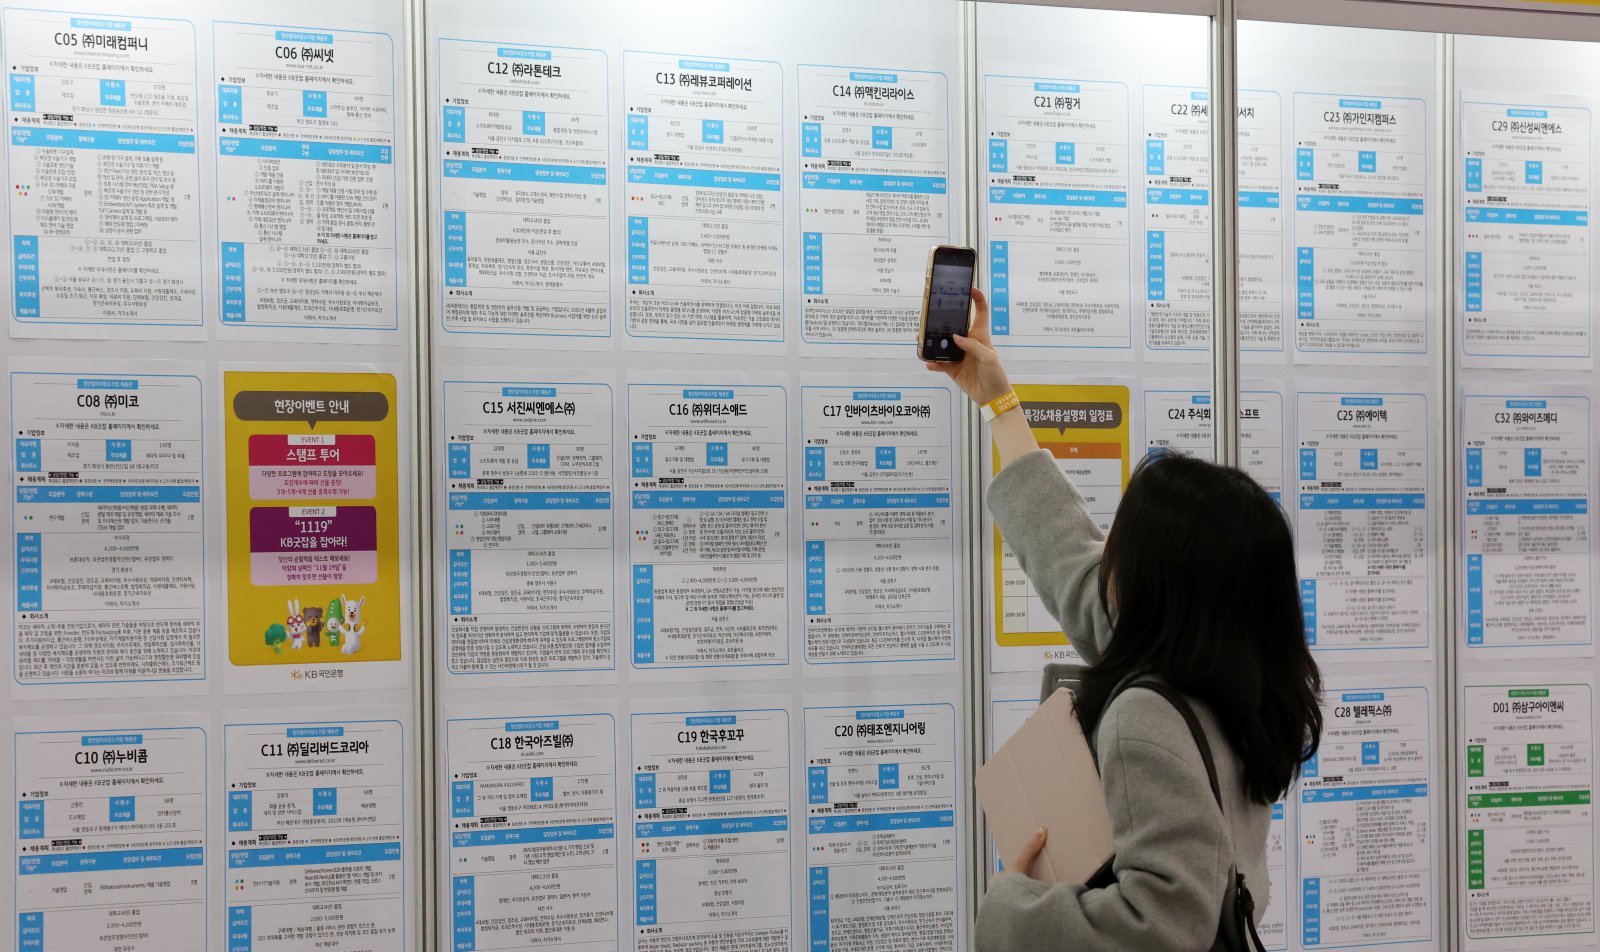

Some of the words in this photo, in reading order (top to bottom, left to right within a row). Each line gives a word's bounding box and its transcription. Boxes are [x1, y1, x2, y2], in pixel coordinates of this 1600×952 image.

[54, 32, 78, 46] C05
[82, 33, 148, 51] ㈜미래컴퍼니
[275, 46, 298, 60] C06
[301, 46, 334, 63] ㈜씨넷
[487, 61, 509, 75] C12
[512, 62, 562, 78] ㈜라톤테크
[656, 72, 676, 85] C13
[679, 72, 752, 92] ㈜레뷰코퍼레이션
[832, 85, 852, 97] C14
[854, 86, 915, 101] ㈜맥킨리라이스
[1034, 96, 1052, 108] C21
[1054, 96, 1081, 110] ㈜핑거
[1170, 104, 1188, 115] C22
[1323, 111, 1340, 123] C23
[1342, 112, 1397, 125] ㈜가인지캠퍼스
[1491, 120, 1508, 132] C29
[77, 394, 100, 408] C08
[104, 394, 140, 409] ㈜미코
[274, 399, 326, 414] 현장이벤트
[329, 400, 349, 413] 안내
[482, 402, 504, 414] C15
[669, 403, 688, 416] C16
[692, 403, 748, 417] ㈜위더스애드
[823, 405, 841, 417] C17
[844, 404, 931, 419] 인바이츠바이오코아㈜
[1089, 410, 1114, 422] 일정표
[1168, 408, 1185, 420] C24
[1337, 410, 1353, 421] C25
[1356, 409, 1387, 422] ㈜에이텍
[1494, 412, 1510, 424] C32
[1513, 412, 1558, 424] ㈜와이즈메디
[286, 448, 317, 463] 스탬프
[319, 449, 340, 462] 투어
[280, 536, 318, 548] KB굿잡을
[319, 536, 348, 548] 잡아라!
[304, 669, 344, 679] KB국민은행
[1334, 706, 1351, 718] C28
[1493, 702, 1509, 713] D01
[677, 731, 697, 744] C19
[699, 728, 745, 744] 한국후꼬꾸
[834, 725, 853, 737] C20
[857, 722, 926, 738] ㈜태조엔지니어링
[490, 737, 512, 750] C18
[514, 733, 574, 750] 한국아즈빌㈜
[261, 743, 283, 757] C11
[287, 740, 369, 758] ㈜딜리버드코리아
[75, 751, 99, 765] C10
[102, 748, 148, 765] ㈜누비콤
